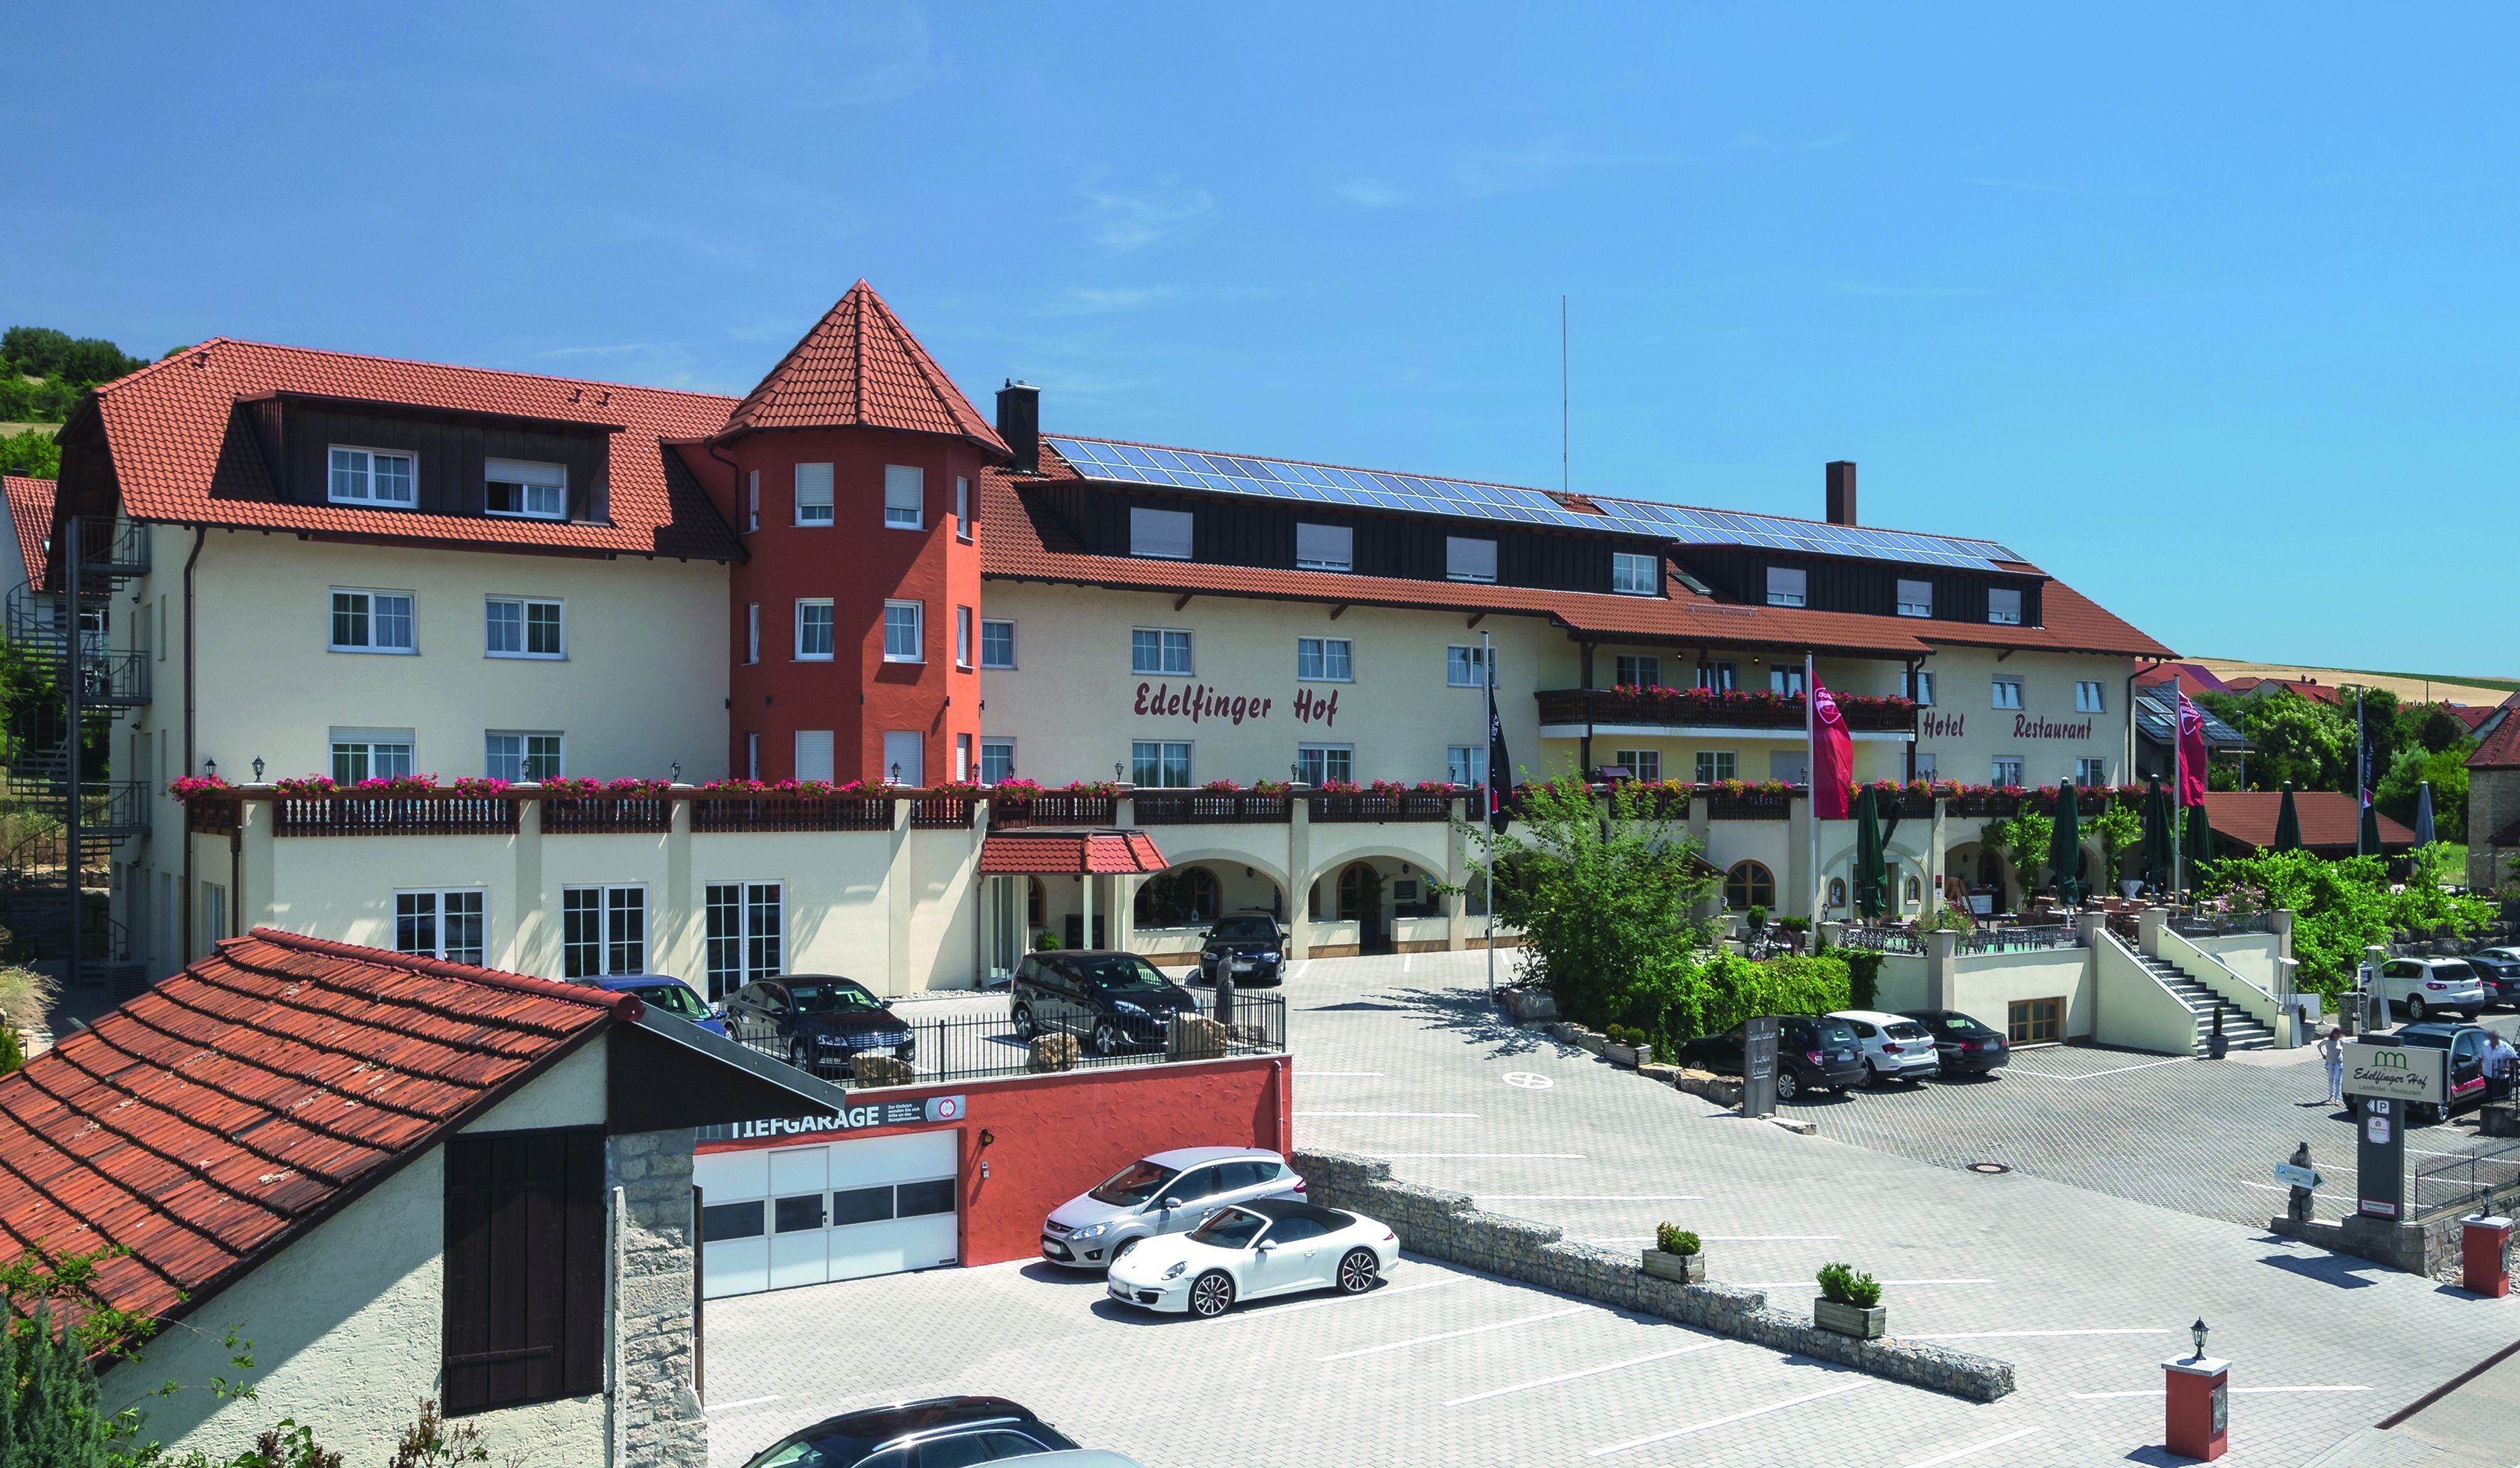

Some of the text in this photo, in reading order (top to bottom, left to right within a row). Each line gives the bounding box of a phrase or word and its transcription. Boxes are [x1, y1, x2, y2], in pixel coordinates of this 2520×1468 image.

[1134, 682, 1339, 728] Edelfinger Hof
[1923, 711, 2092, 740] Hotel Restaurant
[2353, 1068, 2428, 1090] Edelfinger Hof
[2359, 1083, 2386, 1092] Landhotel
[2391, 1087, 2422, 1096] Restaurant
[2379, 1102, 2387, 1112] P
